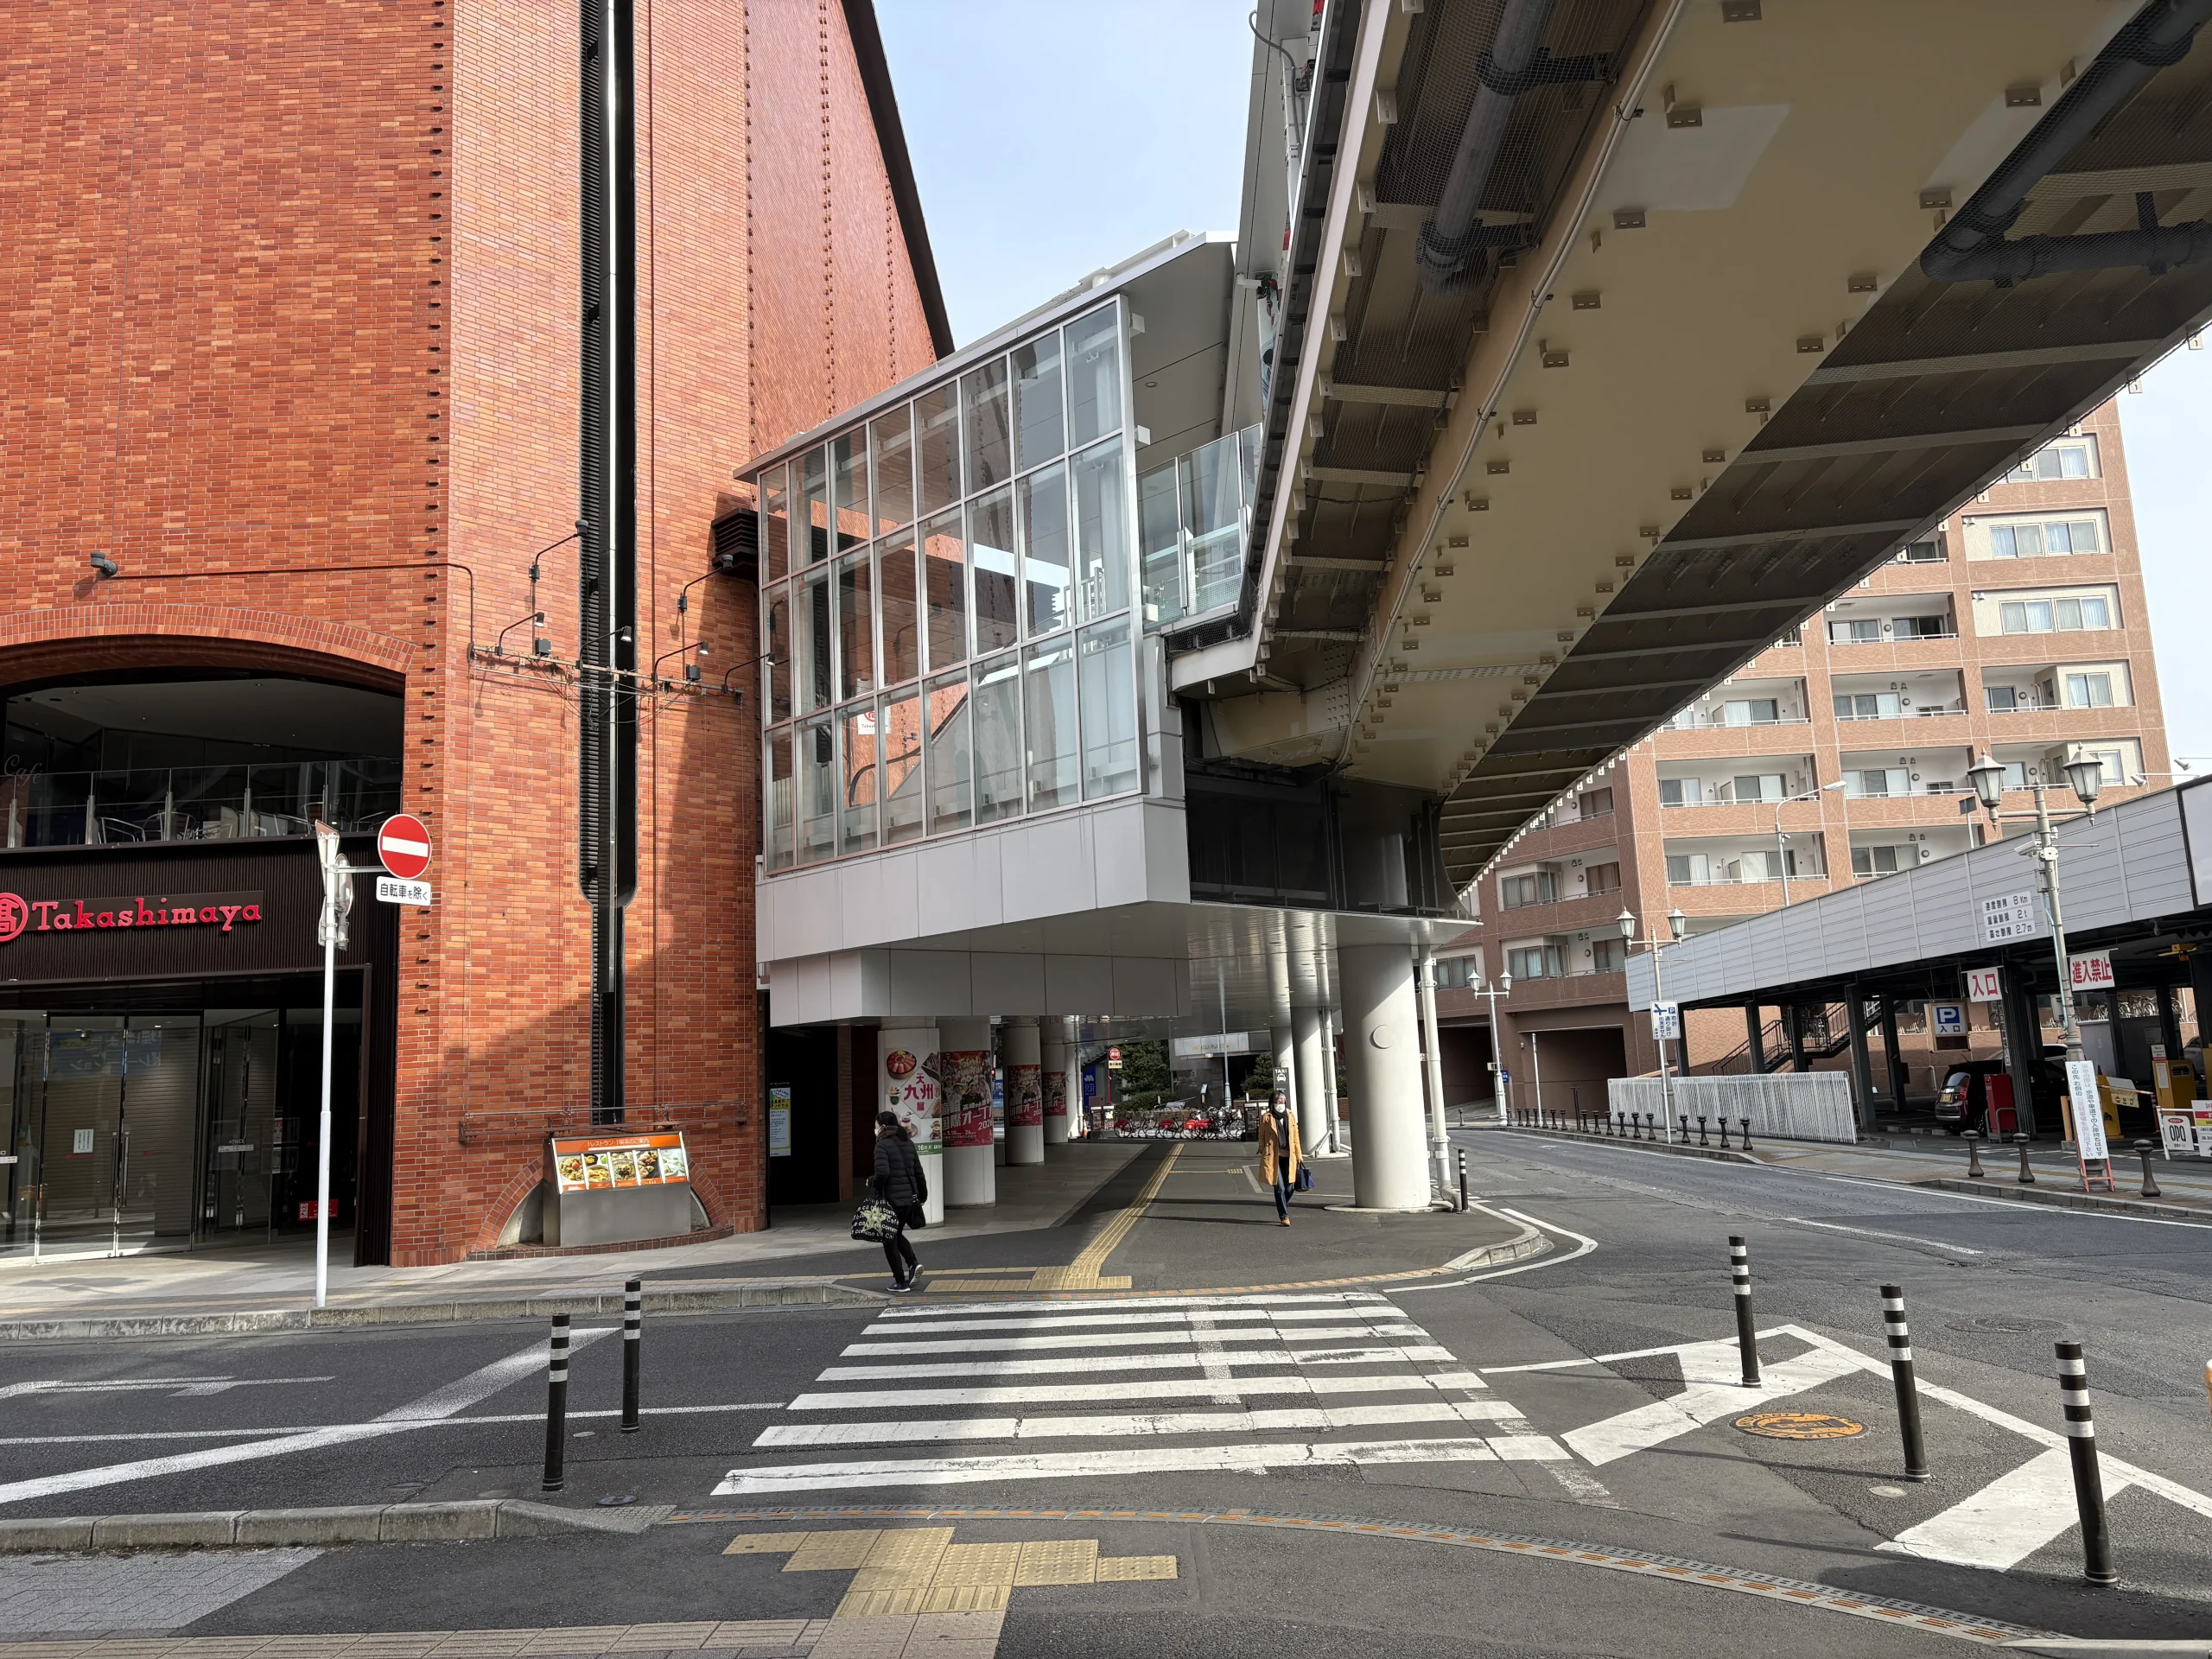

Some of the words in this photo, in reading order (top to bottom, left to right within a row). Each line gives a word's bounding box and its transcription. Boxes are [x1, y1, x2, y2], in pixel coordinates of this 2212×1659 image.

[380, 883, 427, 900] 自転車を除く
[32, 898, 262, 931] Takashimaya
[1989, 926, 2012, 938] 高さ制限
[2072, 957, 2112, 984] 進入禁止
[1973, 974, 1999, 997] 入口
[1939, 1008, 1958, 1022] P
[903, 1084, 933, 1101] 九州
